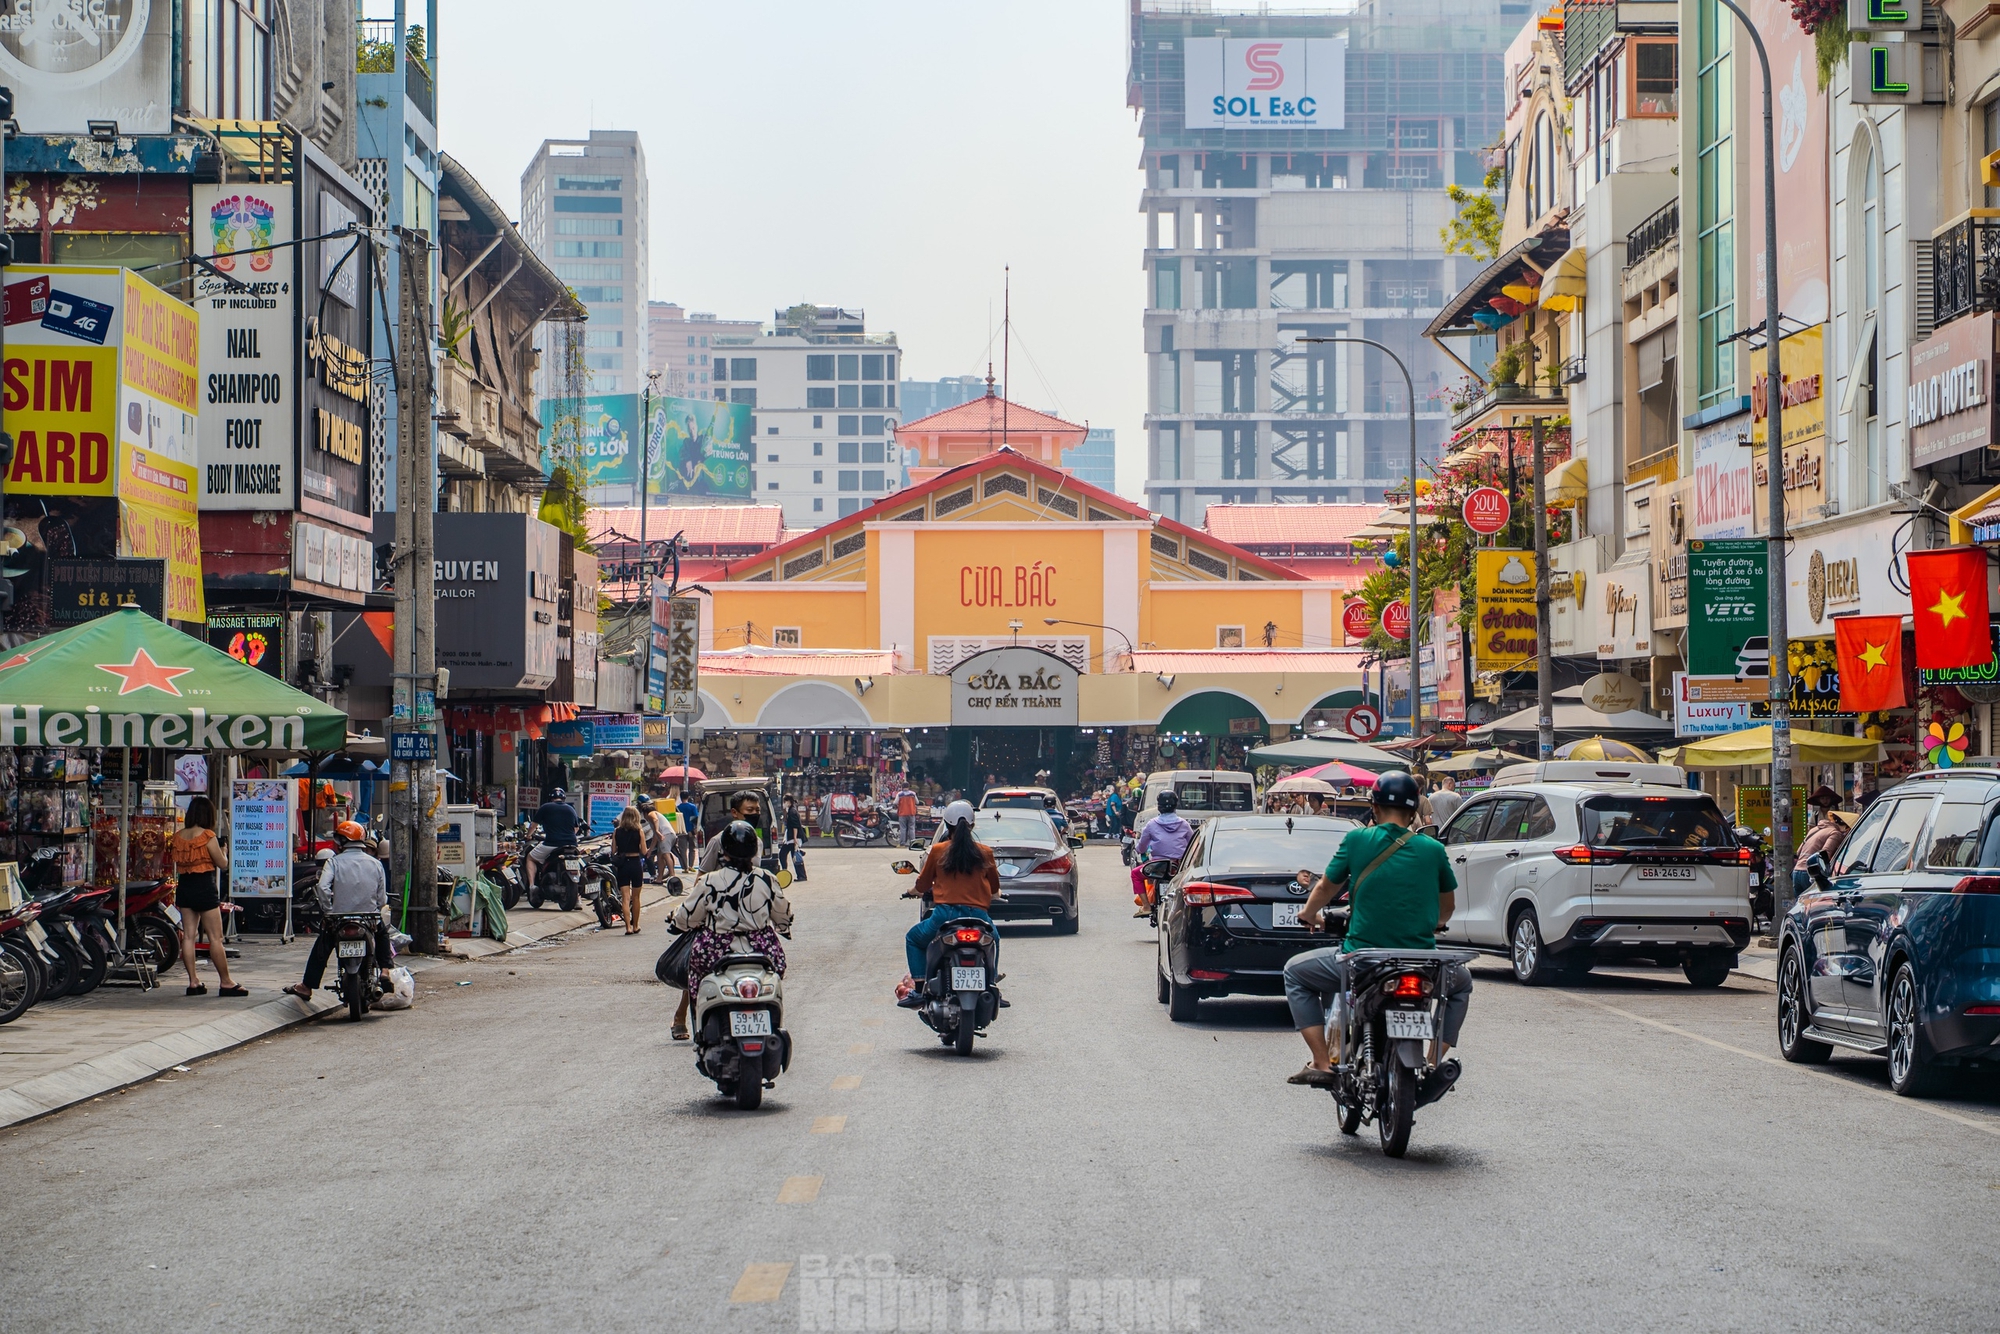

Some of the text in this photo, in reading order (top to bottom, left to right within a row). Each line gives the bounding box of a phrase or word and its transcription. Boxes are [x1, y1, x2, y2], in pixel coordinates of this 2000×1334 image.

[1213, 96, 1317, 116] SOL E&C
[199, 278, 224, 298] Spa
[212, 299, 277, 309] TIP INCLUDED
[73, 316, 98, 332] 4G
[126, 284, 141, 339] BUY
[141, 298, 154, 346] and
[155, 301, 170, 355] SELL
[172, 310, 197, 368] PHONES
[227, 329, 261, 359] NAIL
[125, 345, 145, 387] PHONE
[4, 358, 93, 413] SIM
[208, 373, 281, 404] SHAMPOO
[1908, 358, 1982, 429] HALO HOTEL
[226, 418, 262, 449] FOOT
[318, 407, 362, 466] TIP INCLUDED
[600, 436, 629, 456] LỚN
[2, 431, 109, 485] ARD
[207, 464, 232, 495] BODY
[235, 464, 282, 495] MASSAGE
[1696, 462, 1718, 527] KIM
[1719, 466, 1752, 521] TRAVEL
[1473, 494, 1500, 511] SOUL
[154, 517, 172, 560] SIM
[1702, 558, 1754, 568] Tuyến đường
[1708, 568, 1721, 577] phí
[1723, 567, 1733, 576] đỗ
[1747, 567, 1753, 575] ô
[1755, 567, 1763, 575] tô
[1705, 576, 1750, 586] lòng đường
[1826, 557, 1859, 602] HERA
[98, 592, 110, 607] &
[176, 574, 198, 614] DATA
[435, 588, 476, 598] TAILOR
[1704, 603, 1756, 615] VETC
[208, 616, 281, 629] MASSAGE THERAPY
[968, 667, 1062, 690] CỬA BẮC
[187, 688, 211, 696] 1873
[968, 693, 1062, 709] CHỢ BẾN THÀNH
[1687, 706, 1733, 719] Luxury
[608, 715, 640, 726] SERVICE
[1690, 724, 1699, 732] Thu
[1701, 723, 1716, 732] Khoa
[1715, 722, 1729, 731] Huan
[1732, 722, 1743, 731] Ben
[419, 737, 429, 749] 24
[235, 805, 246, 814] FOOT
[246, 805, 264, 814] MASSAGE
[1746, 799, 1761, 807] SPA
[235, 822, 246, 831] FOOT
[246, 822, 264, 831] MASSAGE
[235, 859, 246, 868] FULL
[246, 859, 258, 868] BODY
[1642, 868, 1691, 878] 66A-246.43
[956, 969, 981, 980] 59-P3
[955, 979, 983, 990] 374.76
[1392, 1011, 1426, 1025] 59-CA
[734, 1023, 768, 1035] 534.74
[1391, 1024, 1430, 1038] 117.24
